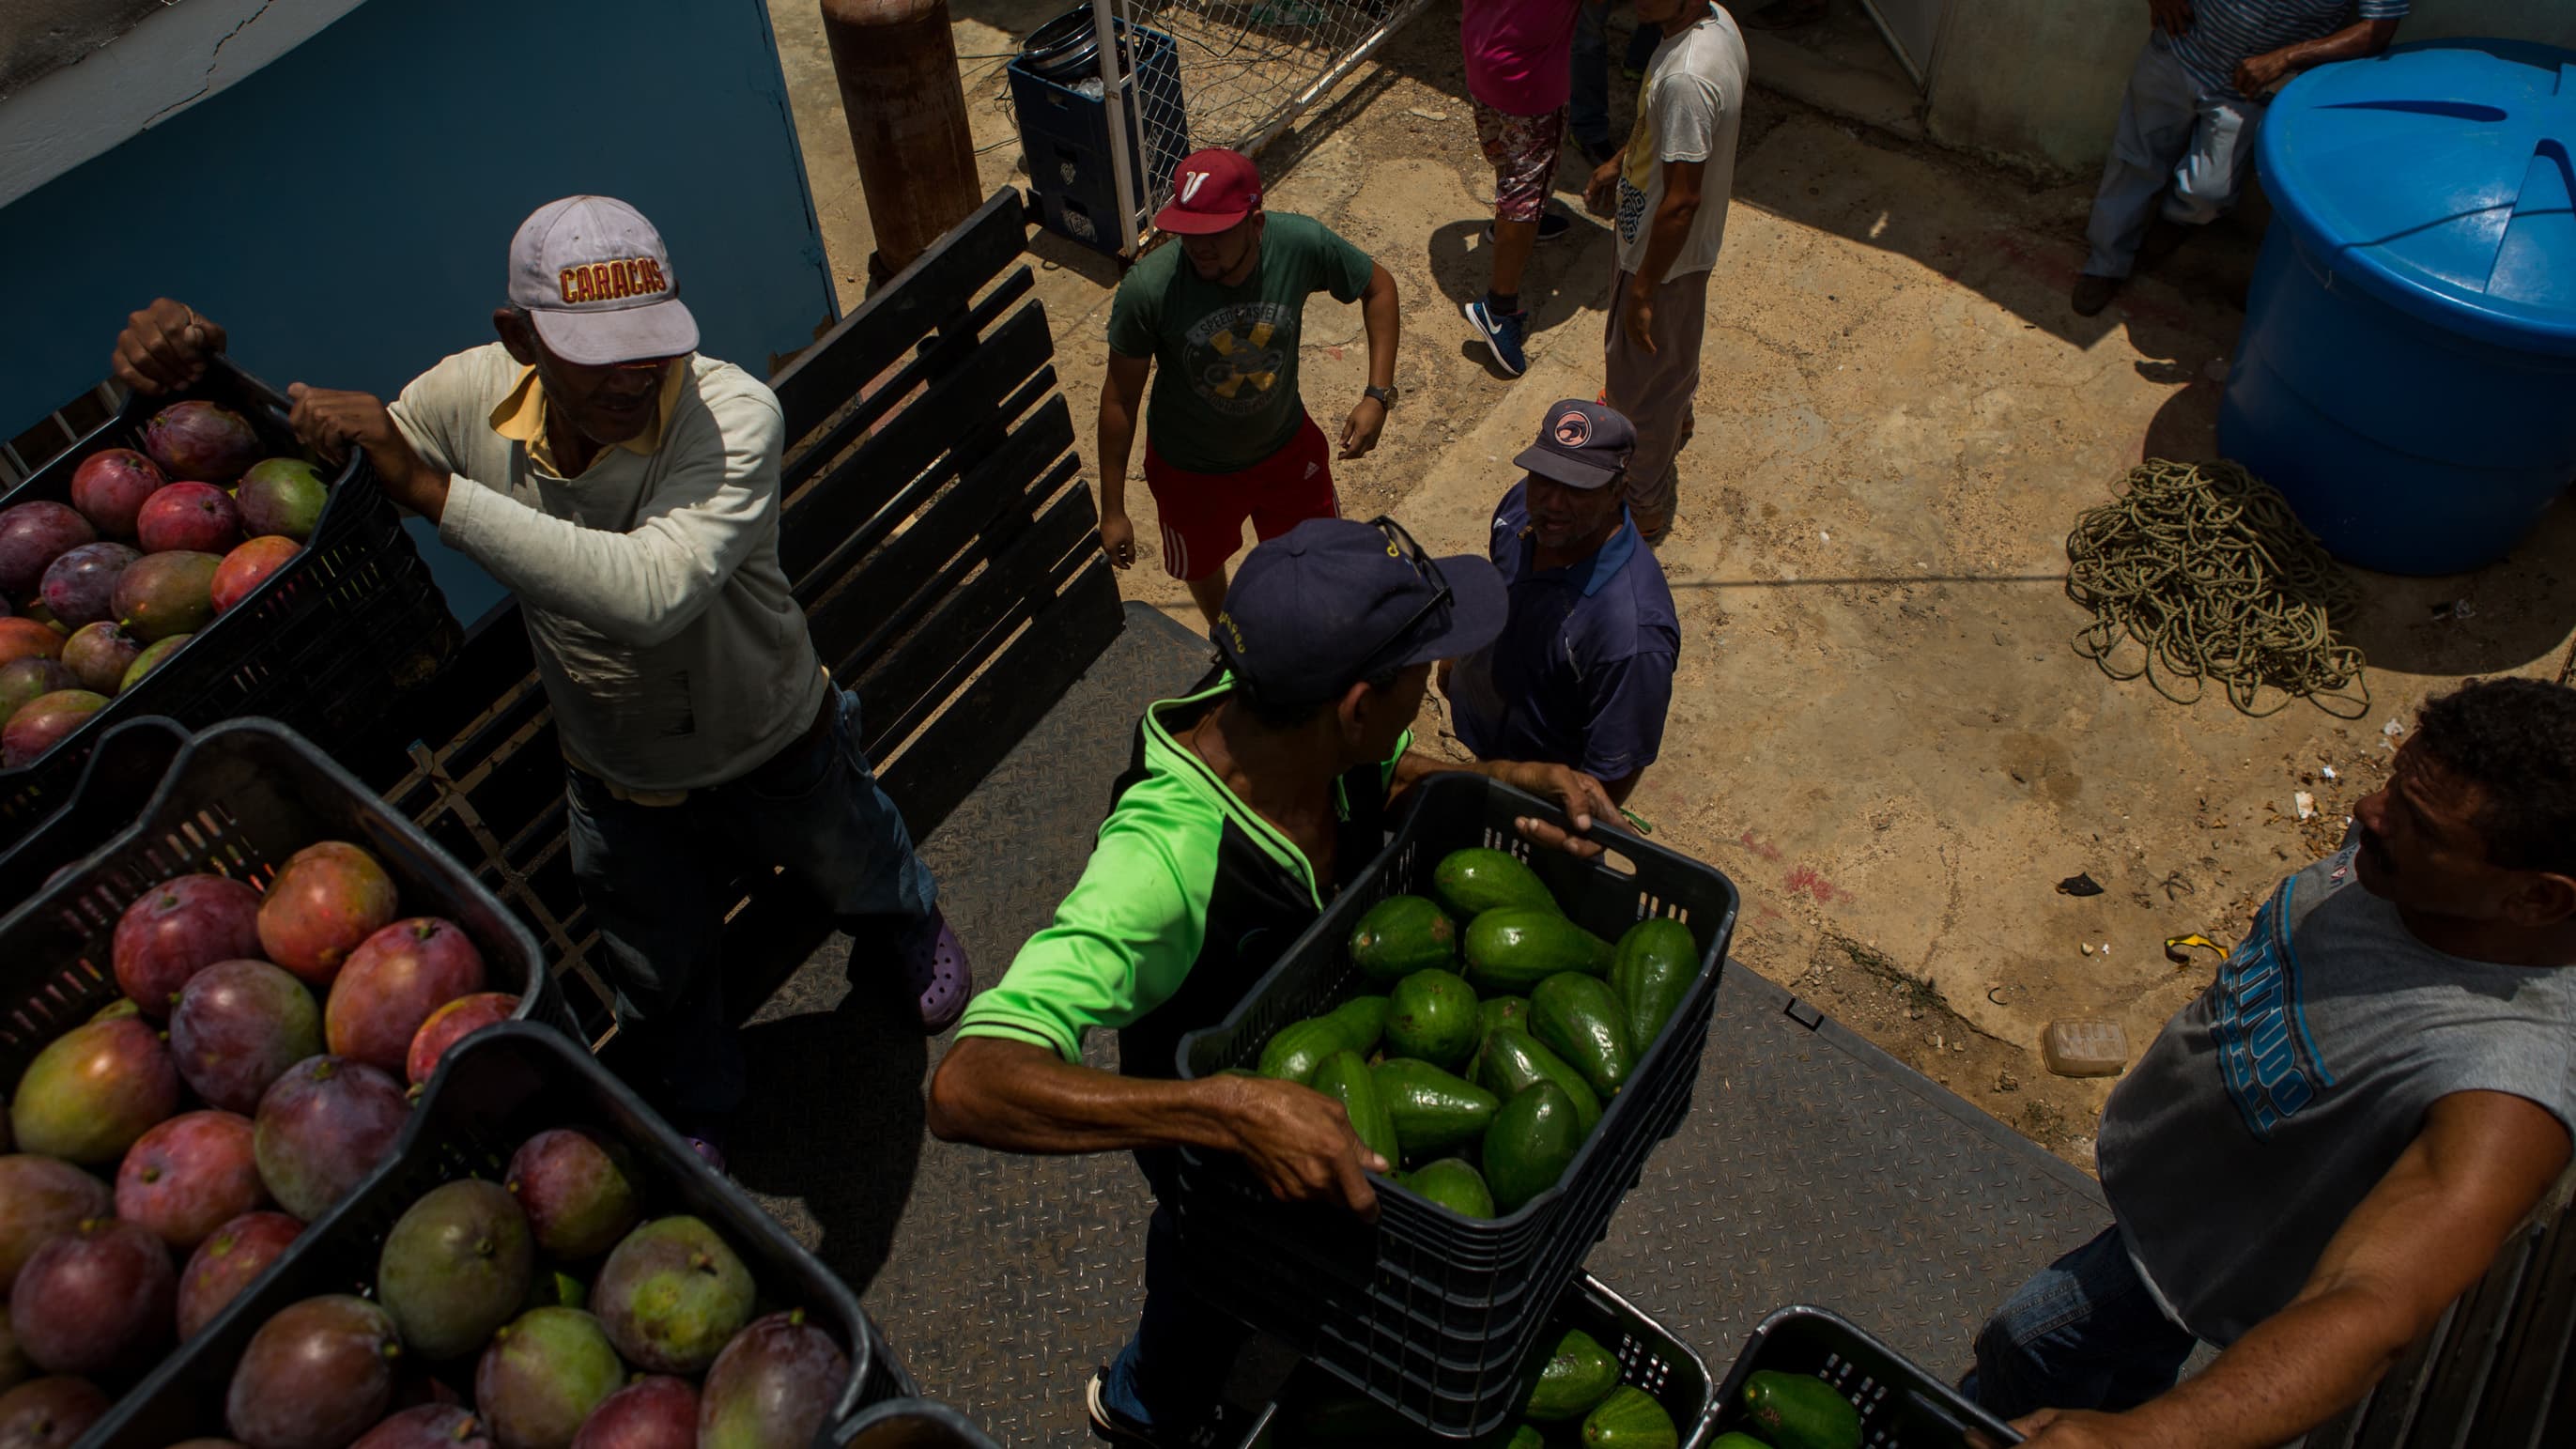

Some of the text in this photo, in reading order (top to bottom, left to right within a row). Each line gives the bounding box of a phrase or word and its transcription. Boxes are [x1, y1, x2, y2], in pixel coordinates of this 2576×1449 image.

[1180, 171, 1211, 205] V
[560, 255, 667, 304] CARACAS
[1200, 309, 1234, 335] SPEED
